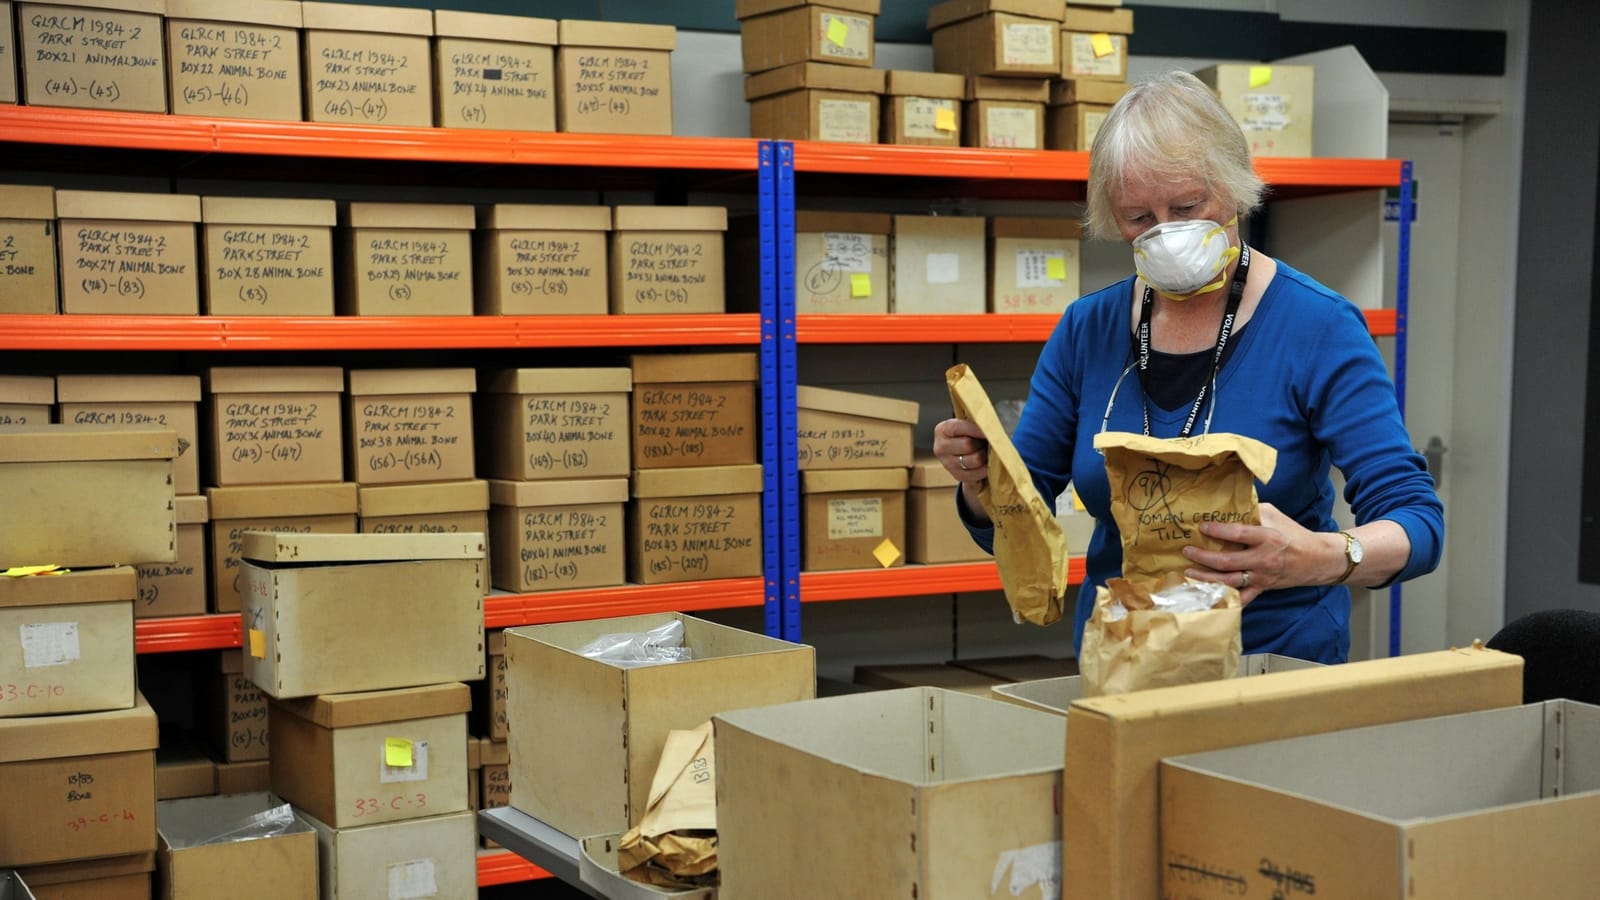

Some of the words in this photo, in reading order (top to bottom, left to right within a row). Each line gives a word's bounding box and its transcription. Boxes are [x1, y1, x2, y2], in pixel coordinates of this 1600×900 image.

[32, 15, 85, 32] GLRCM
[39, 32, 73, 46] PARK
[82, 39, 126, 50] STREET
[181, 28, 225, 42] GLRCM
[186, 45, 219, 59] PARK
[224, 48, 273, 61] STREET
[322, 48, 362, 62] GLRCM
[452, 53, 490, 66] GLRCM
[86, 54, 131, 67] ANIMAL
[131, 57, 159, 67] BONE
[578, 56, 609, 68] GLRCM
[219, 65, 254, 77] ANIMAL
[256, 67, 288, 79] BONE
[325, 62, 351, 73] PARK
[355, 66, 398, 76] STREET
[455, 67, 481, 78] PARK
[503, 71, 539, 82] STREET
[580, 69, 605, 80] PARK
[608, 71, 646, 81] STREET
[351, 81, 387, 92] ANIMAL
[389, 83, 417, 94] BONE
[491, 86, 523, 97] ANIMAL
[527, 89, 547, 99] BONE
[461, 104, 487, 124] (47)
[78, 229, 119, 244] GLRCM
[223, 230, 265, 245] GLRCM
[80, 242, 110, 254] PARK
[115, 246, 164, 257] STREET
[370, 239, 409, 251] GLRCM
[511, 239, 546, 251] GLRCM
[630, 241, 663, 257] GLRCM
[223, 247, 254, 261] PARK
[256, 248, 302, 262] STREET
[371, 253, 398, 265] PARK
[402, 254, 446, 265] STREET
[516, 252, 537, 263] PARK
[540, 253, 578, 264] STREET
[6, 264, 34, 275] BONE
[118, 261, 155, 274] ANIMAL
[157, 264, 186, 275] BONE
[631, 258, 656, 270] PARK
[659, 258, 698, 270] STREET
[262, 267, 294, 279] ANIMAL
[297, 267, 324, 279] BONE
[404, 268, 436, 281] ANIMAL
[438, 271, 460, 282] BONE
[239, 285, 268, 305] (83)
[643, 391, 682, 405] GLRCM
[226, 403, 269, 417] GLRCM
[364, 404, 408, 418] GLRCM
[527, 399, 568, 413] GLRCM
[1182, 385, 1207, 435] VOLUNTEER
[75, 411, 116, 425] GLRCM
[226, 417, 259, 429] PARK
[260, 416, 311, 429] STREET
[530, 413, 558, 426] PARK
[561, 415, 606, 427] STREET
[641, 410, 667, 421] PARK
[670, 410, 719, 423] STREET
[364, 421, 390, 432] PARK
[393, 421, 441, 431] STREET
[262, 429, 295, 441] ANIMAL
[296, 428, 323, 439] BONE
[396, 435, 427, 447] ANIMAL
[431, 435, 458, 446] BONE
[559, 431, 586, 443] ANIMAL
[588, 431, 613, 442] BONE
[650, 505, 688, 519] GLRCM
[525, 513, 562, 526] GLRCM
[526, 530, 553, 542] PARK
[556, 529, 596, 542] STREET
[649, 523, 680, 536] PARK
[683, 521, 732, 535] STREET
[1151, 527, 1192, 542] TILE
[553, 545, 582, 559] ANIMAL
[583, 544, 608, 556] BONE
[682, 539, 721, 552] ANIMAL
[723, 537, 753, 550] BONE
